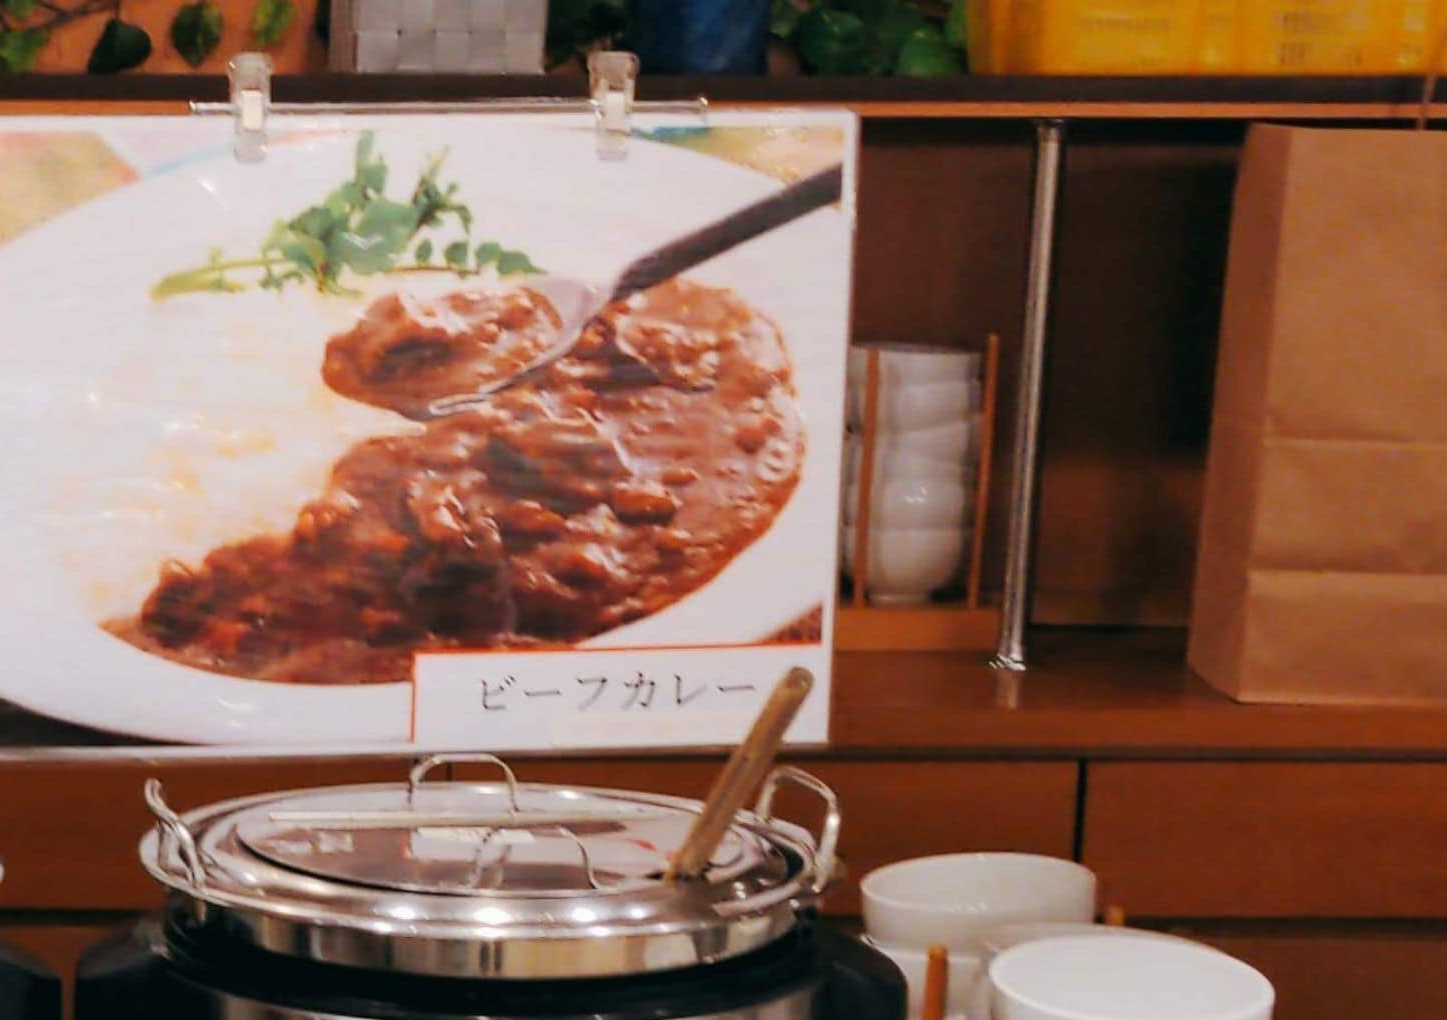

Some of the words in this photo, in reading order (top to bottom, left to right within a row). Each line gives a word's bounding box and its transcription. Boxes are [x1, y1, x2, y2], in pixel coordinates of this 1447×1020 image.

[482, 671, 756, 711] ビーフカレー
